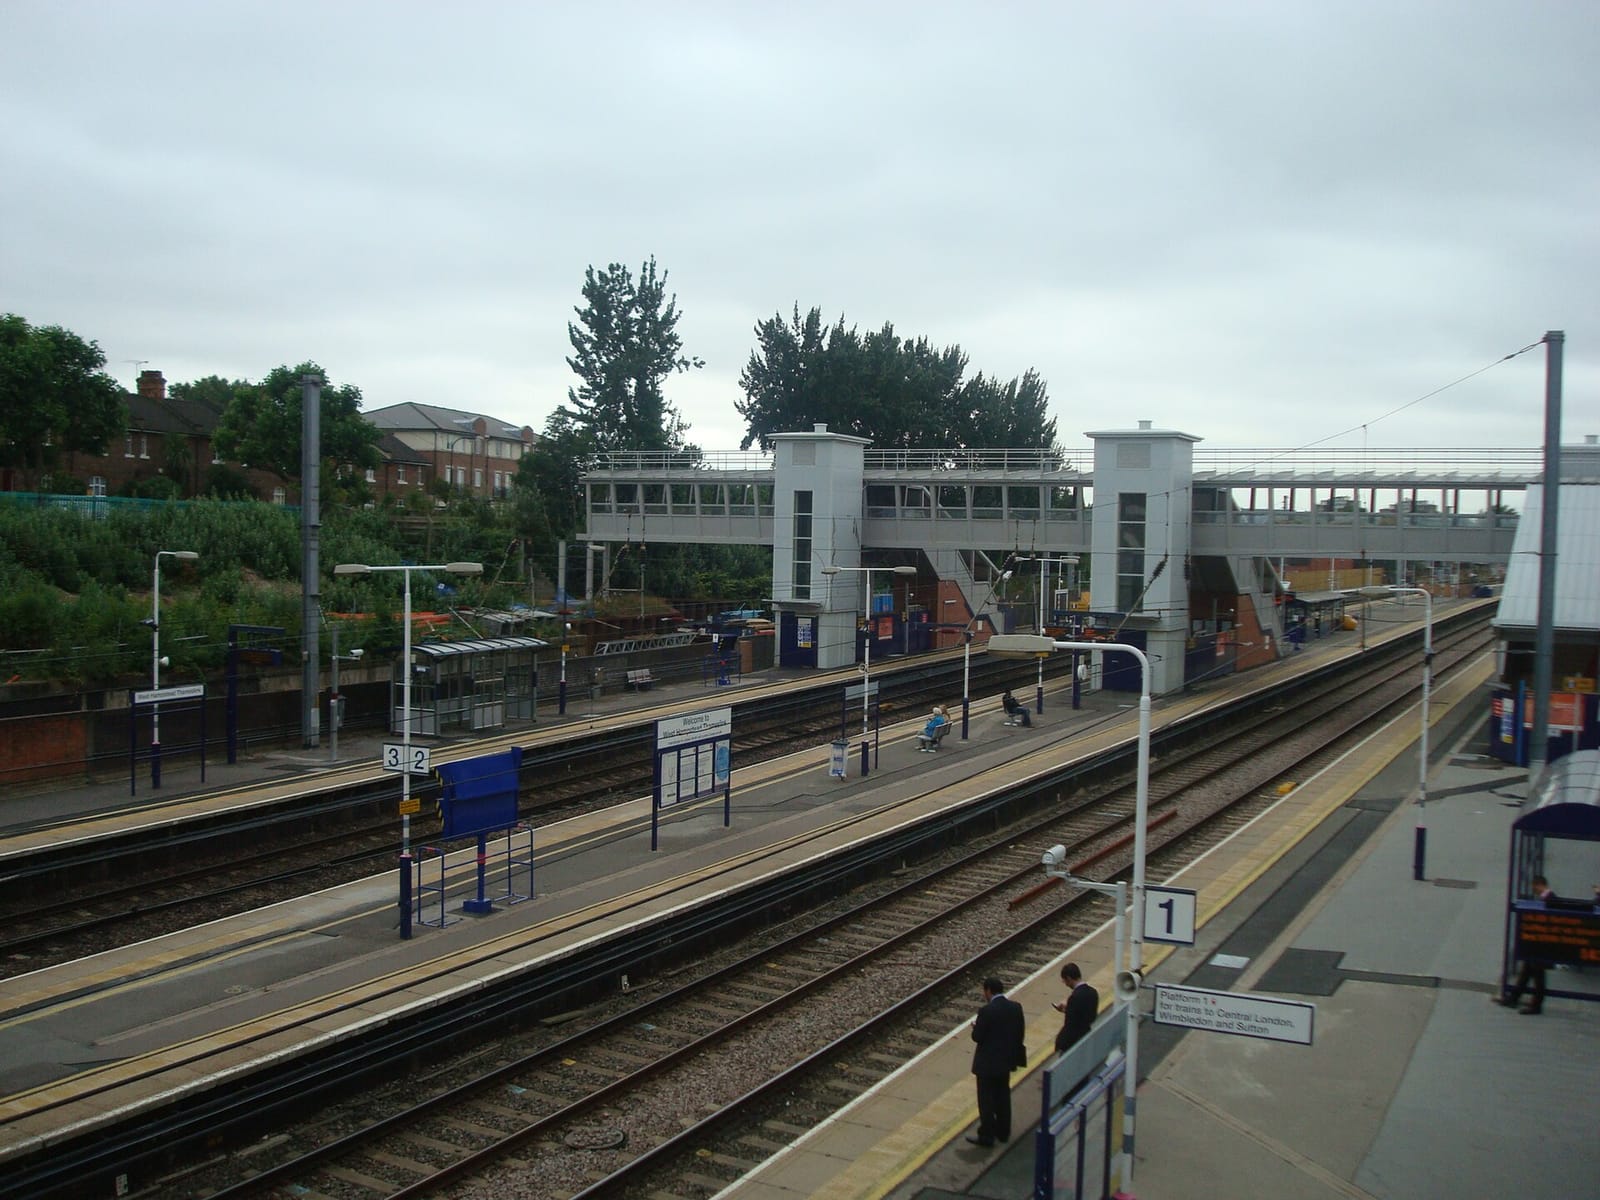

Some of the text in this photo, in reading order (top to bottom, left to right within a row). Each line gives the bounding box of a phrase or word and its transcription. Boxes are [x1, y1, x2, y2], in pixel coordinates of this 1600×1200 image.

[683, 716, 704, 726] Welcome
[389, 748, 399, 767] 3
[415, 751, 424, 769] 2
[1158, 898, 1174, 934] 1
[1160, 991, 1200, 1003] Platform
[1160, 1002, 1173, 1010] for
[1175, 1004, 1202, 1014] trains
[1204, 1007, 1215, 1016] to
[1217, 1008, 1252, 1021] Central
[1160, 1011, 1270, 1034] Wimbledon and Sutton
